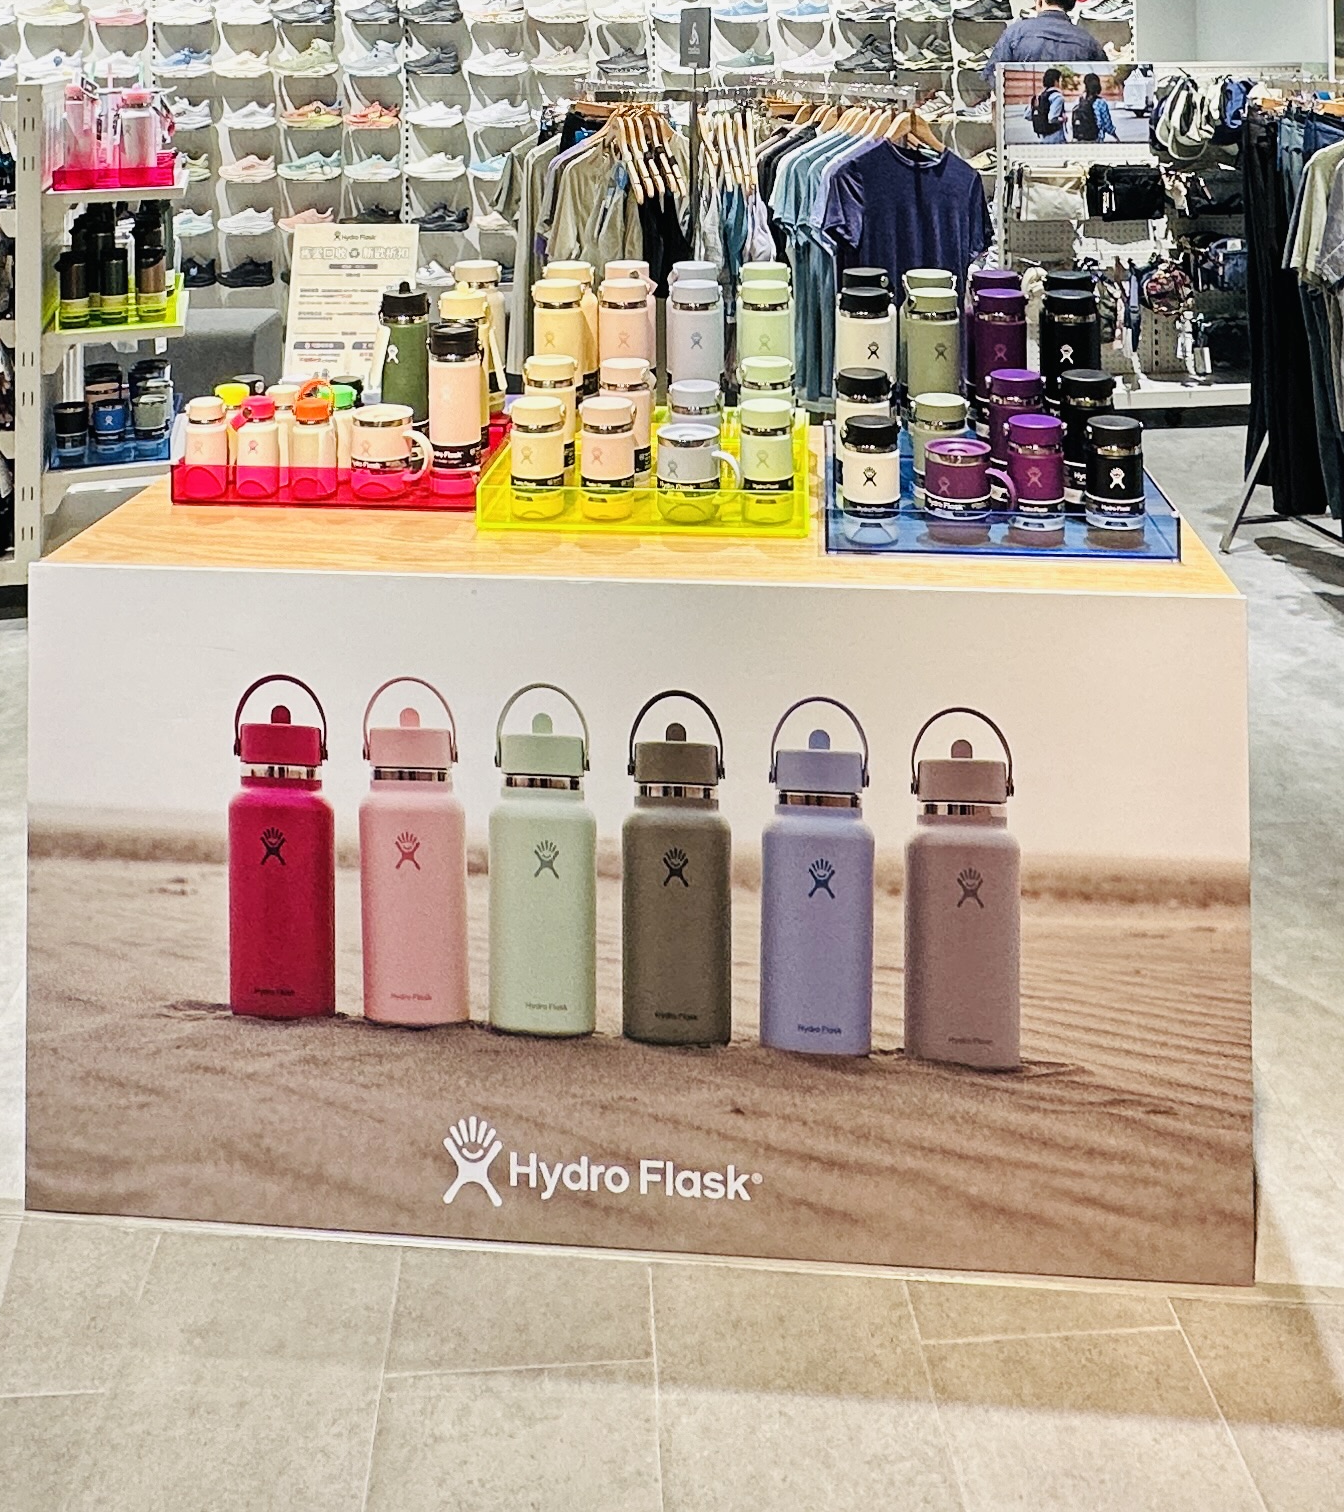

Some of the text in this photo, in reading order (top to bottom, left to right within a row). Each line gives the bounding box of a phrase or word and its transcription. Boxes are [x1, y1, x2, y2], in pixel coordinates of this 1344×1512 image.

[342, 234, 359, 242] Hydro
[797, 1023, 842, 1035] Hydro Flask
[509, 1151, 630, 1199] Hydro
